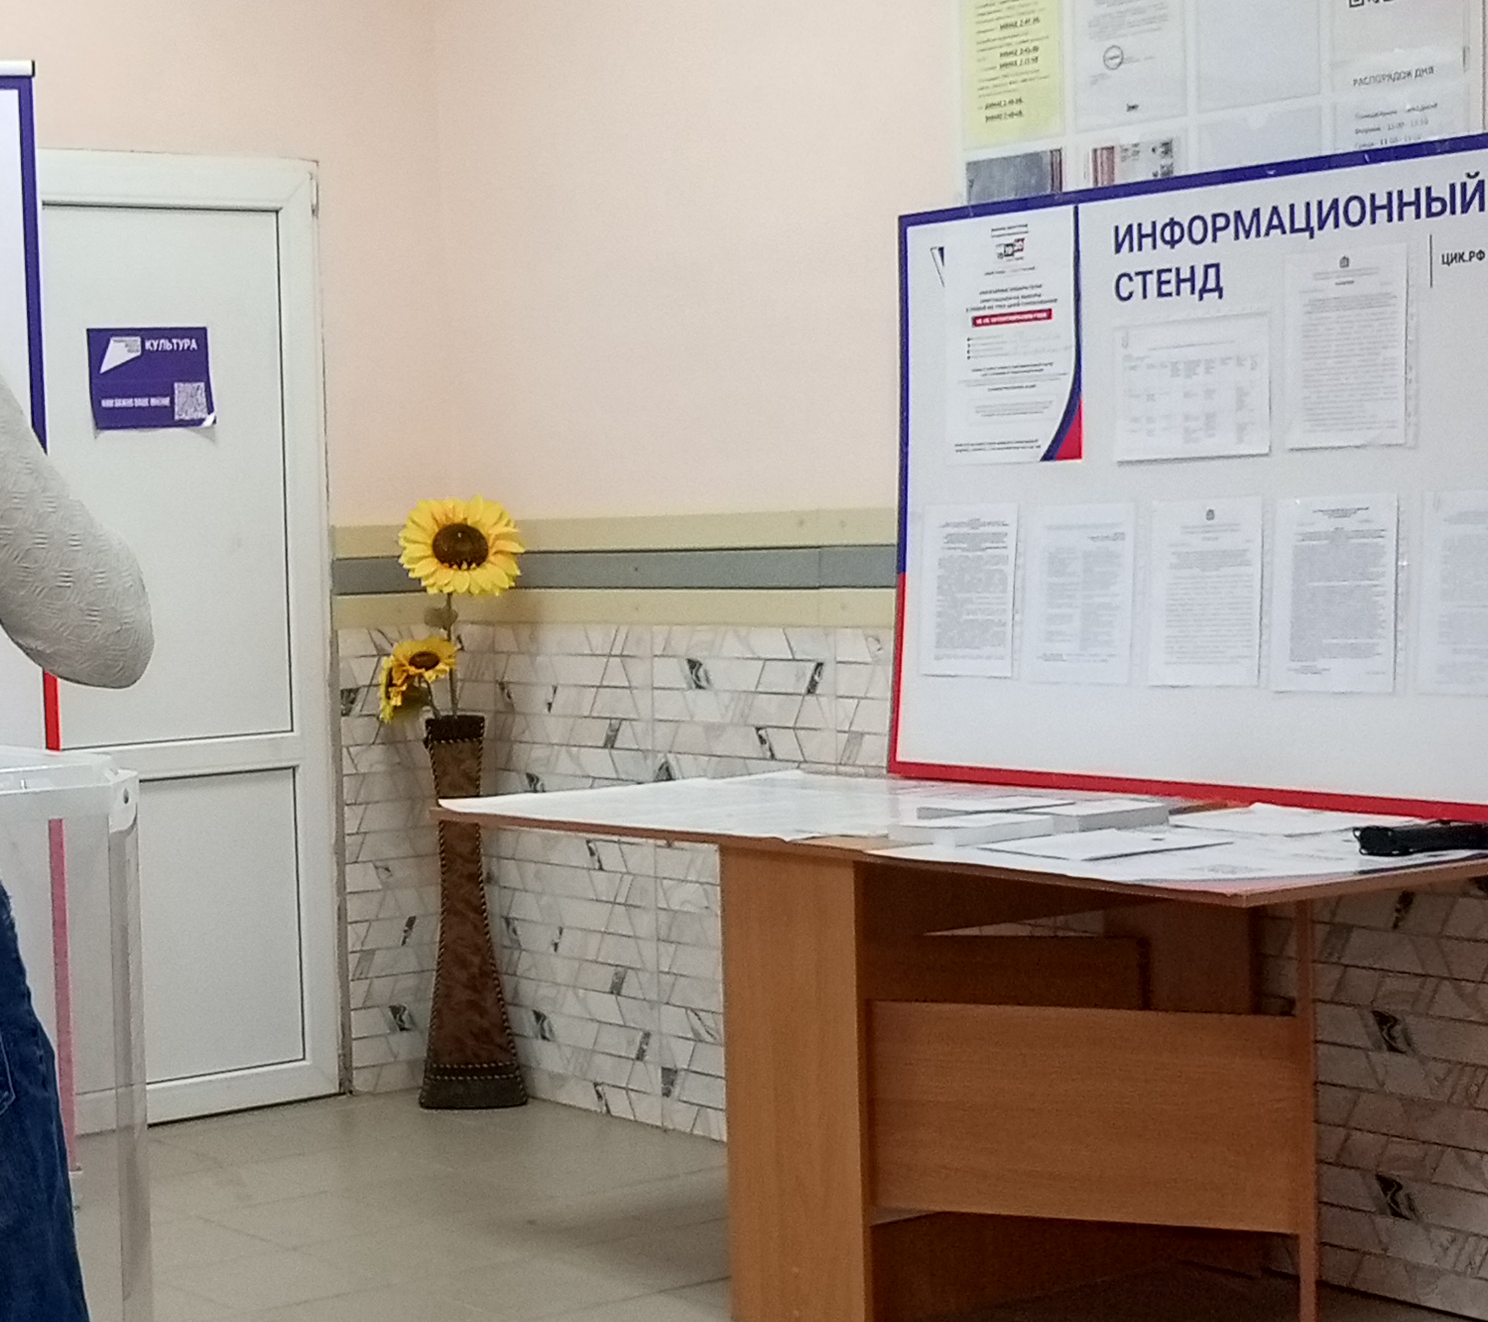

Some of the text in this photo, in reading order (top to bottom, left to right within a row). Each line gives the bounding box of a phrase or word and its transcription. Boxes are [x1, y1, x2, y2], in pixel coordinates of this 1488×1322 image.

[1114, 171, 1487, 255] ИНФОРМАЦИОННЫЙ
[1441, 249, 1486, 267] ЦИК.РФ
[1114, 262, 1224, 302] СТЕНД
[144, 338, 198, 351] КУЛЬТУРА
